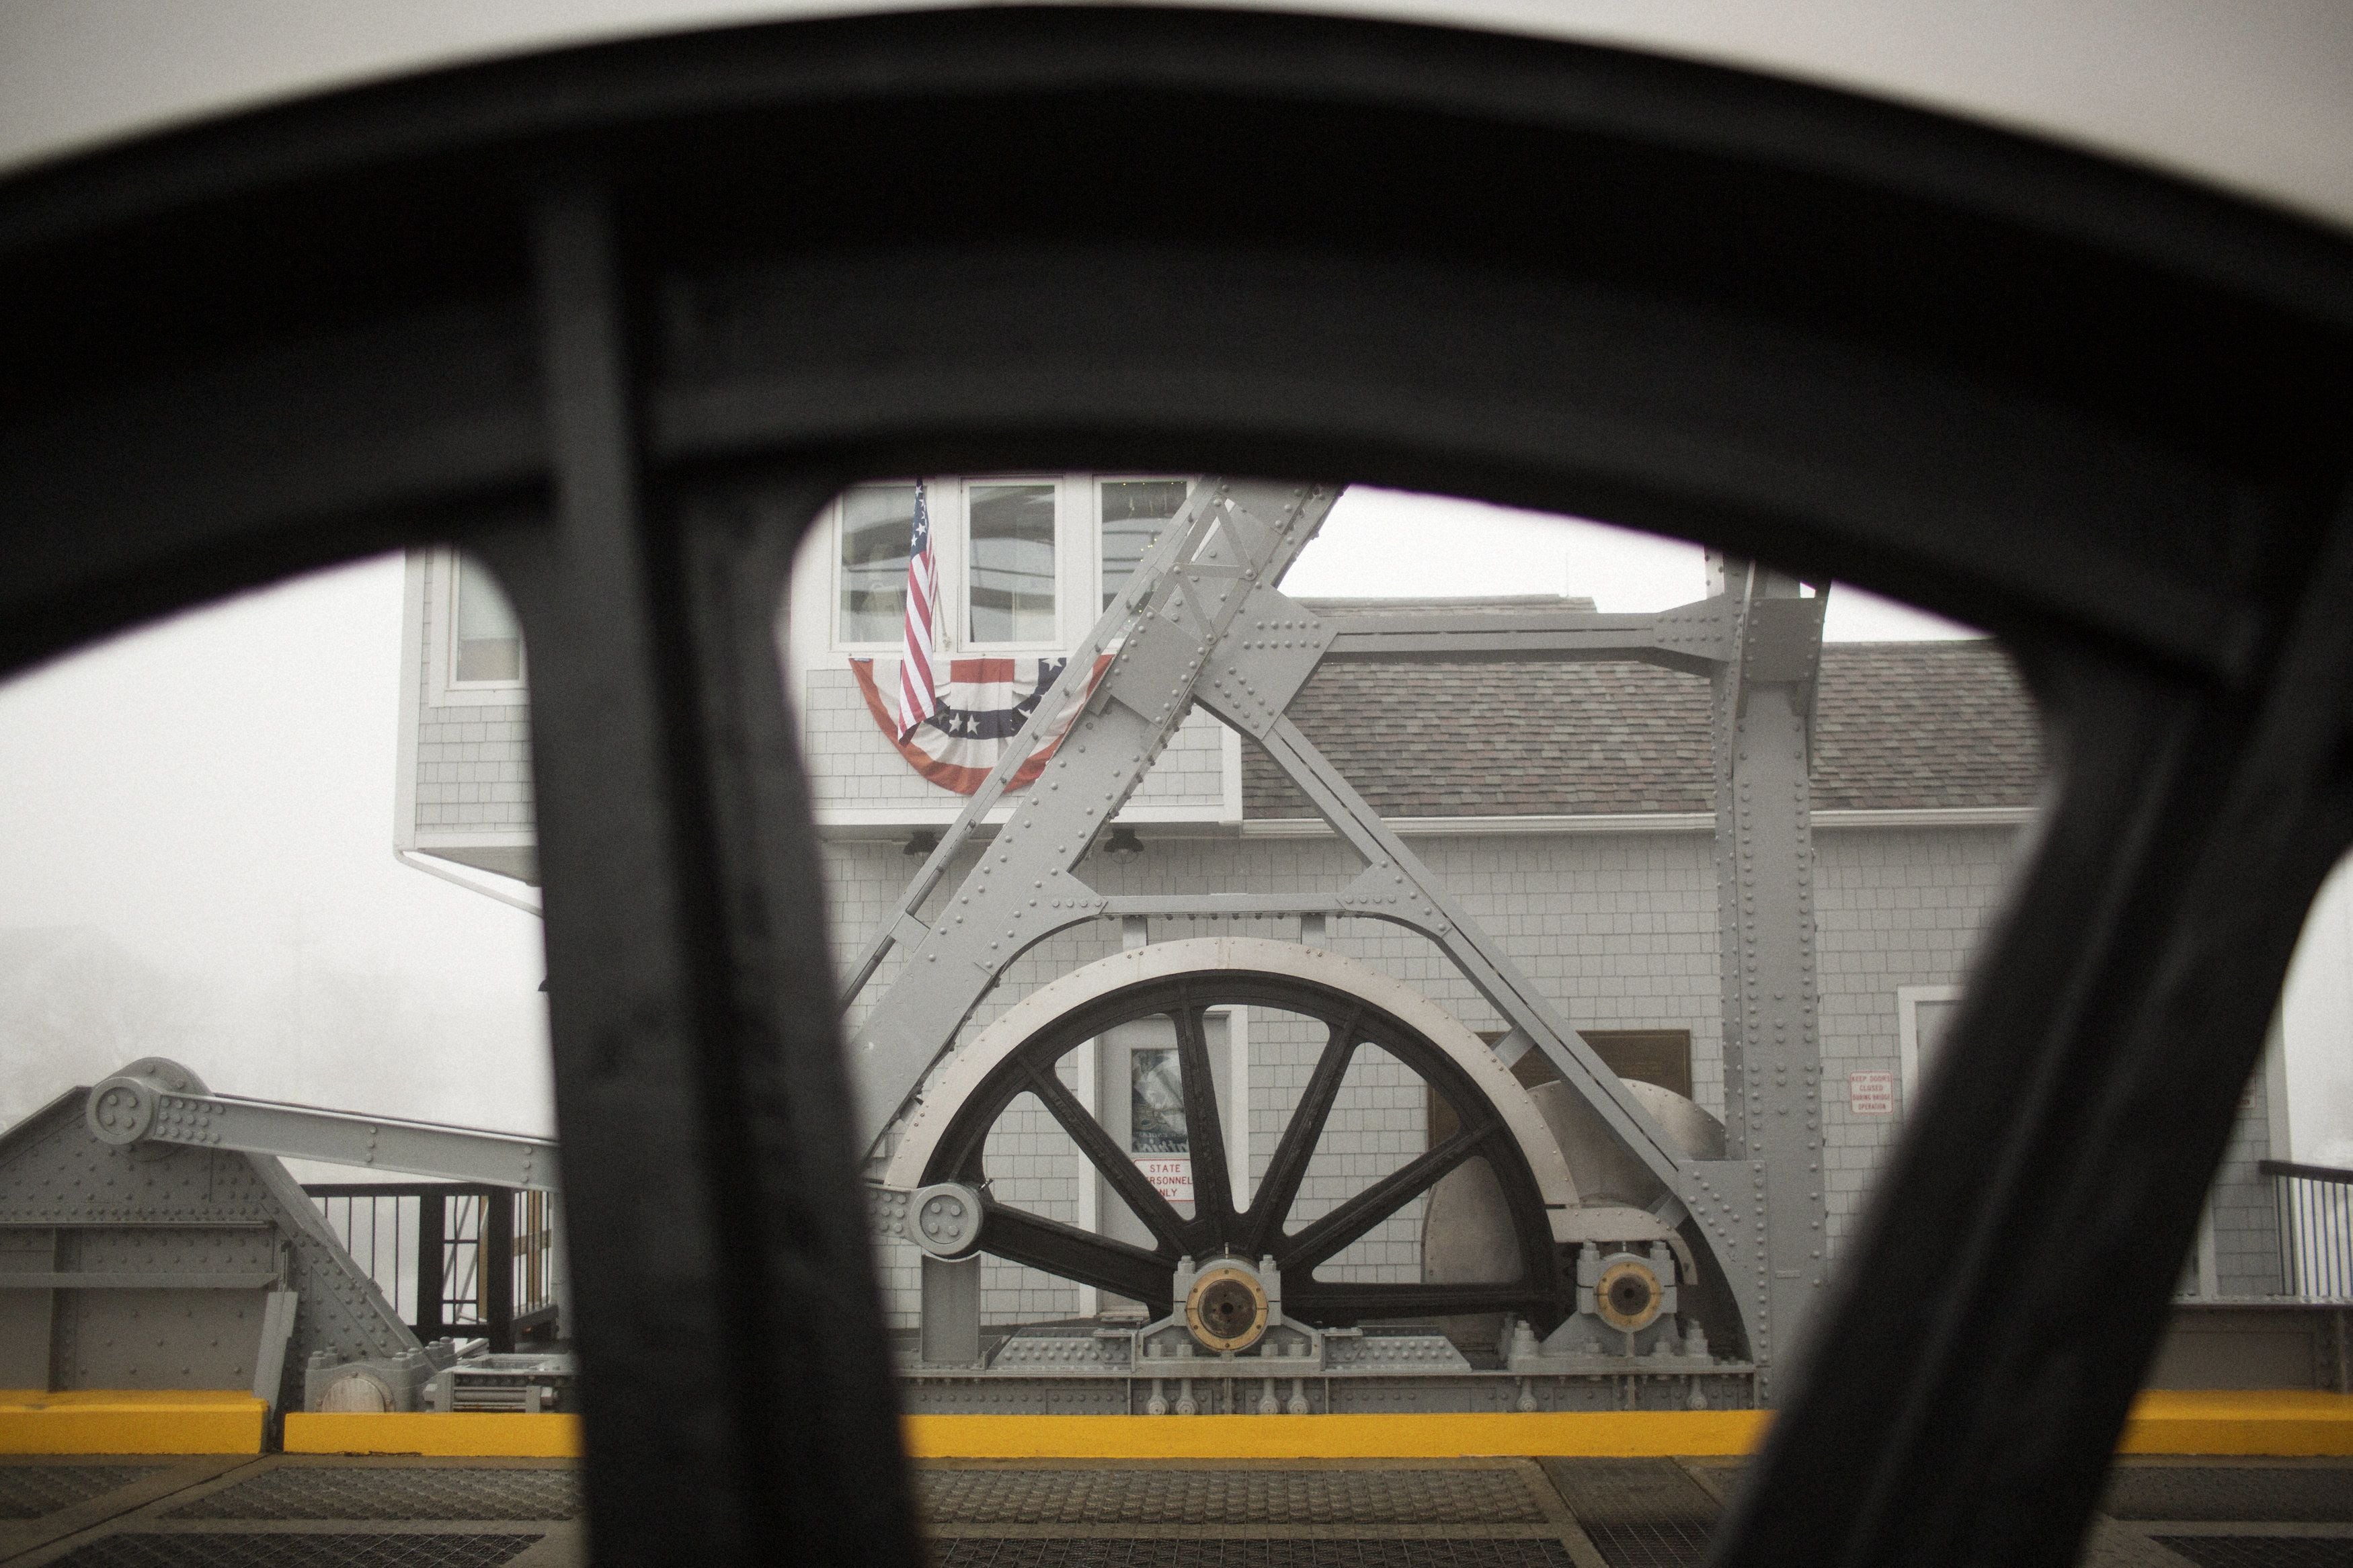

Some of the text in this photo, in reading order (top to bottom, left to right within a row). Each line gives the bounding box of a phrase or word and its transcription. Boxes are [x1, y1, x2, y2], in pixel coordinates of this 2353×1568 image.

[1150, 1164, 1181, 1173] STATE
[1146, 1176, 1193, 1184] RSONNEL
[1159, 1188, 1177, 1196] NLY
